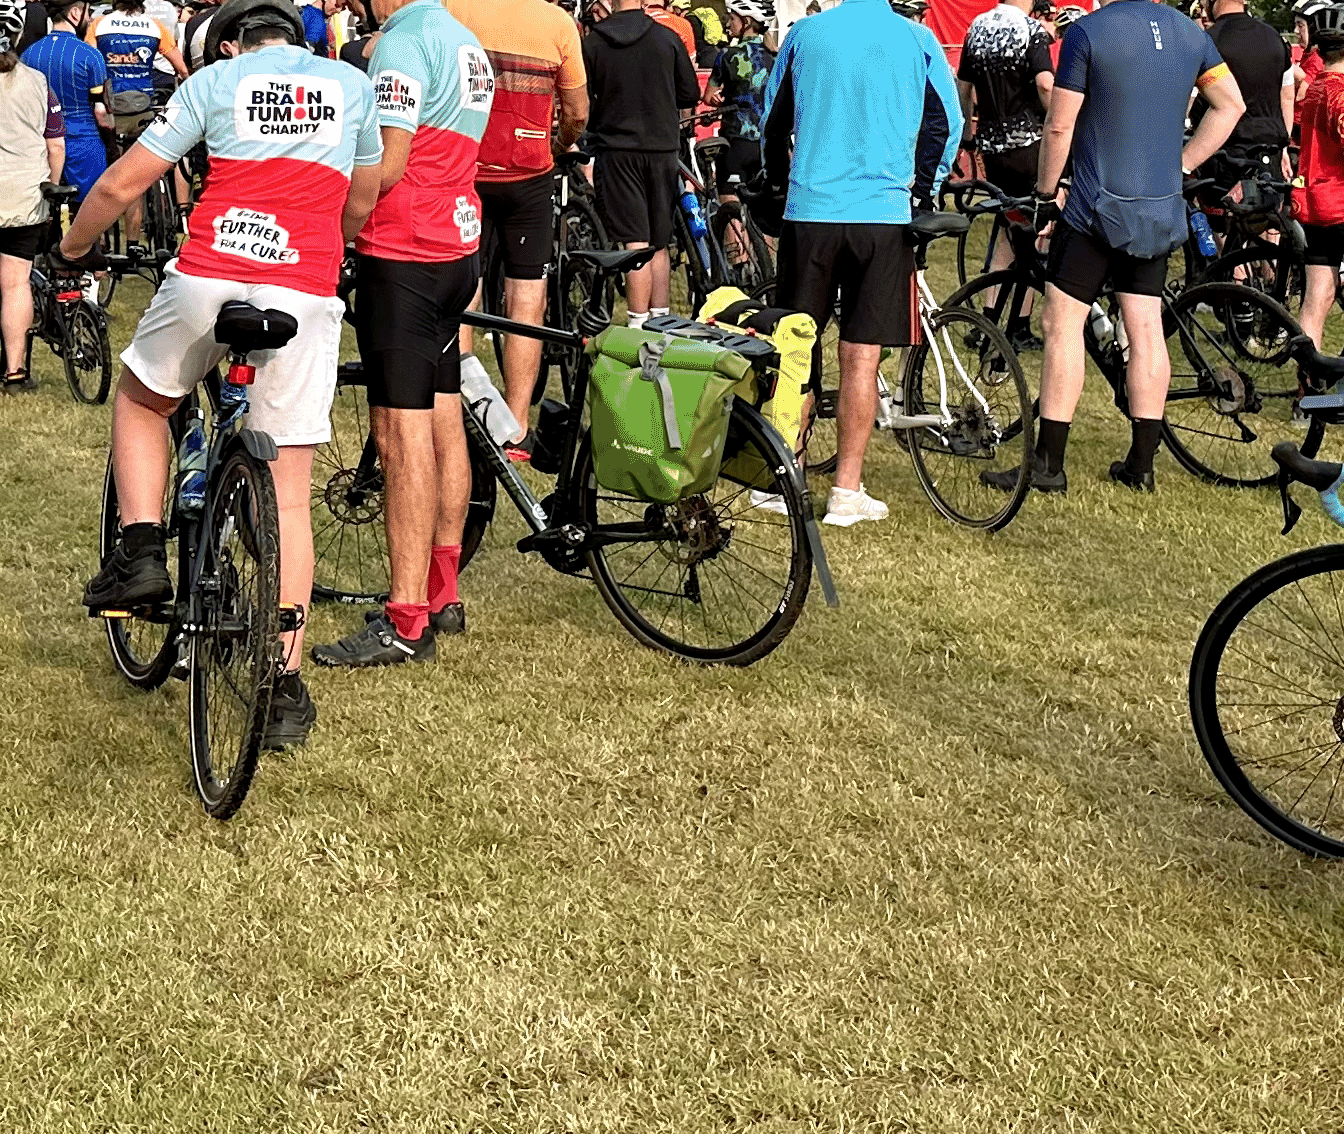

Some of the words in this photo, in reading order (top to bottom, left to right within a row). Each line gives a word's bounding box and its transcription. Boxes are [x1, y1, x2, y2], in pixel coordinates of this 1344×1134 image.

[110, 19, 150, 29] NOAH
[268, 81, 293, 93] THE
[251, 86, 322, 105] BRAIN
[246, 106, 336, 122] TUMOUR
[260, 123, 321, 135] CHARITY
[220, 220, 280, 245] FURTHER
[238, 243, 246, 251] A
[250, 243, 296, 261] CURE!
